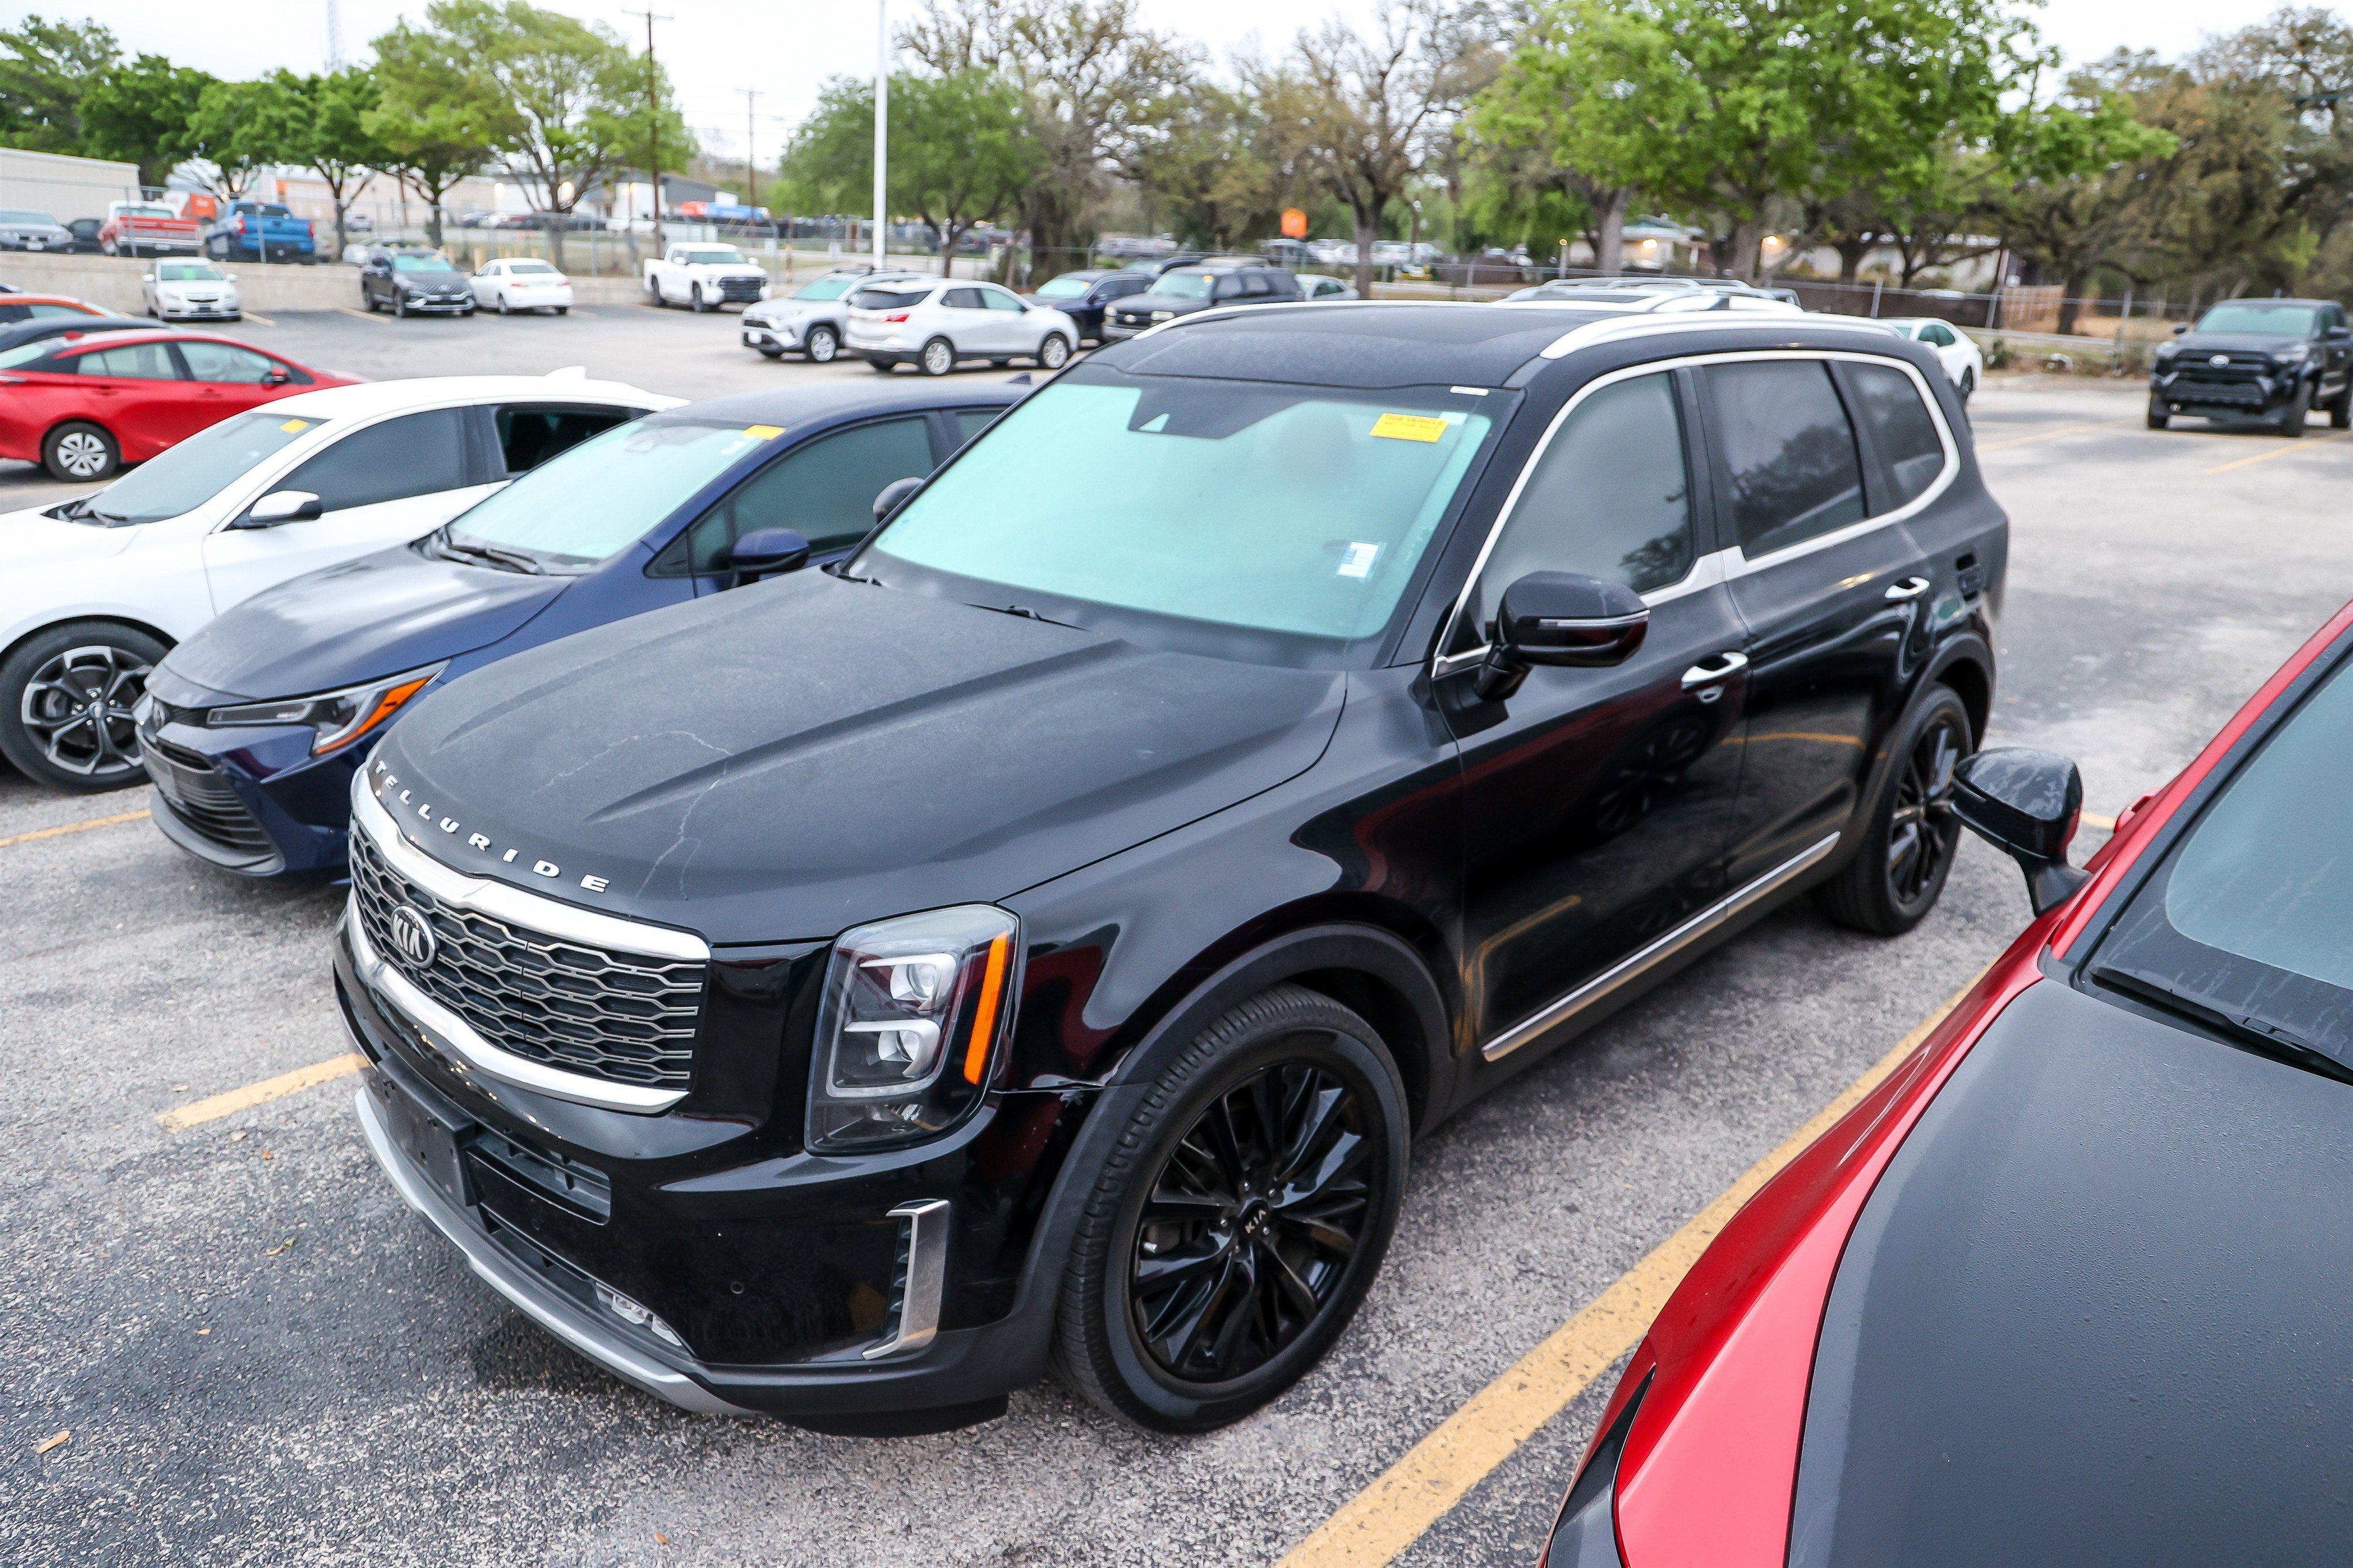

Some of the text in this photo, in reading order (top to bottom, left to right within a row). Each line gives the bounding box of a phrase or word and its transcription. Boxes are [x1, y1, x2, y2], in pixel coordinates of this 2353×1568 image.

[375, 760, 610, 893] TELLURIDE
[393, 913, 424, 960] KIA
[1244, 1209, 1267, 1234] KIA
